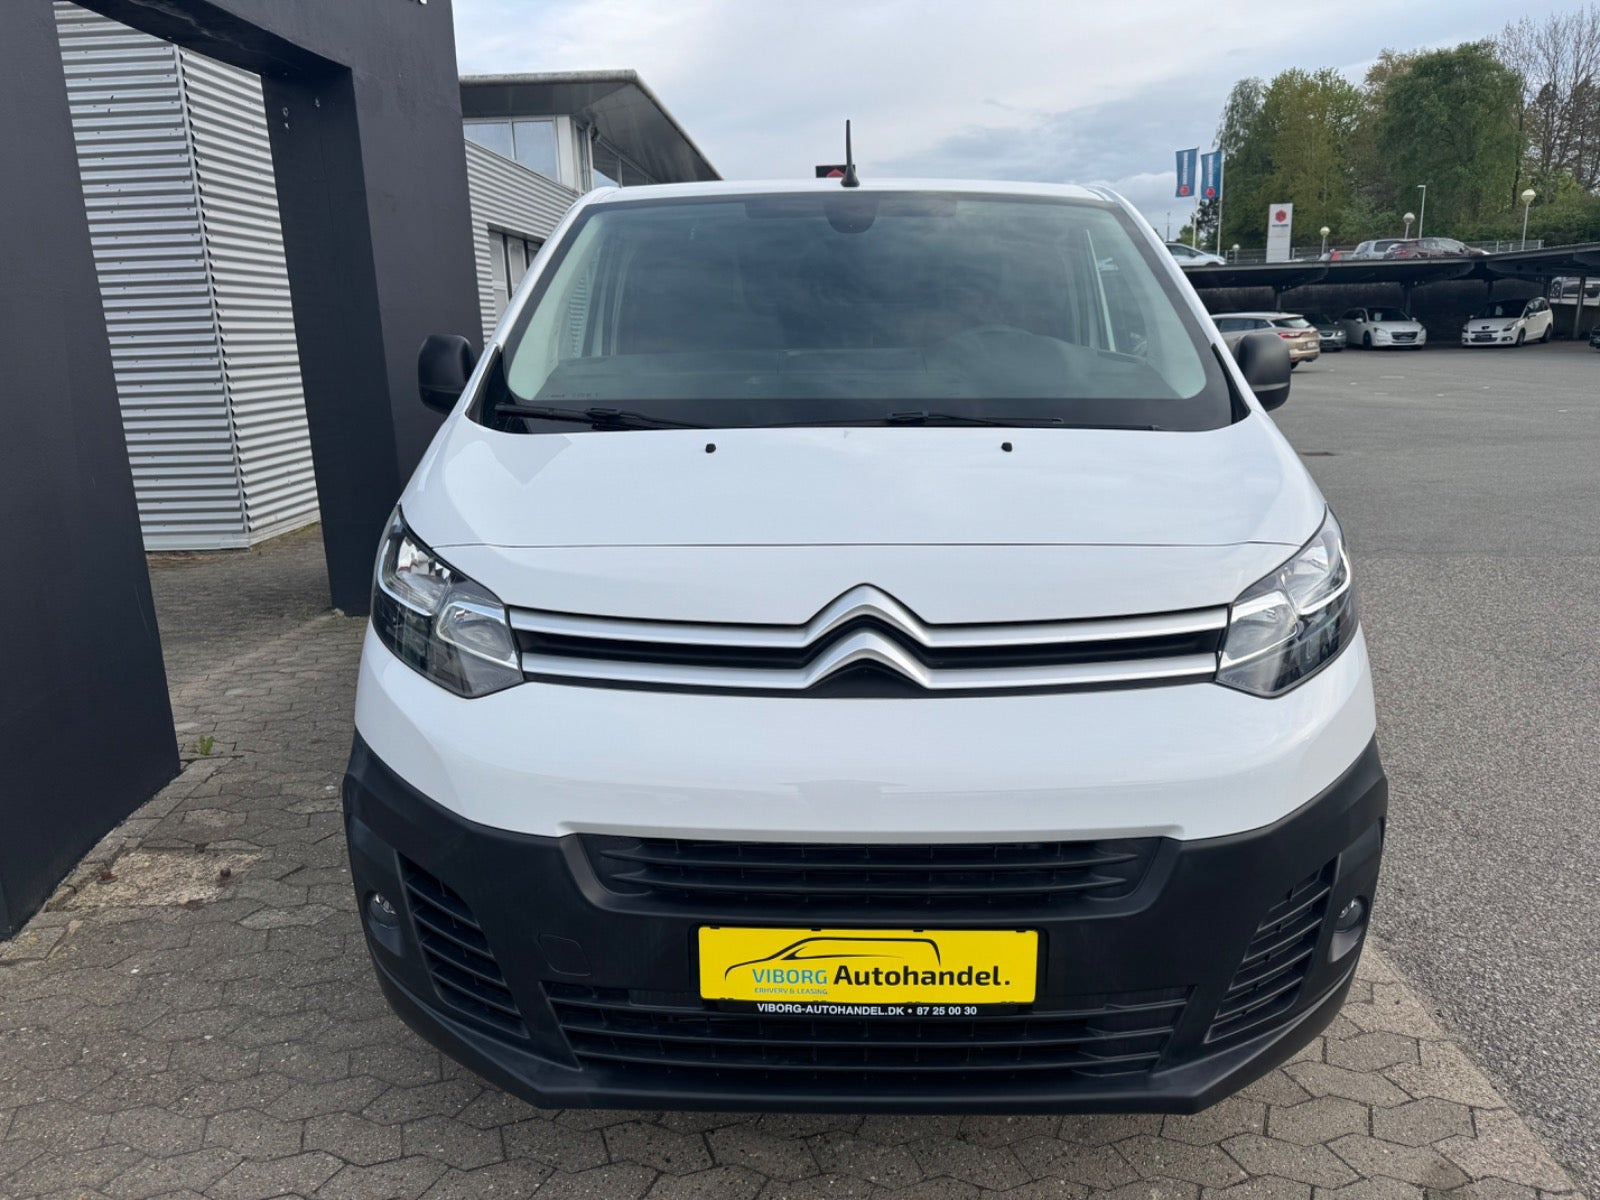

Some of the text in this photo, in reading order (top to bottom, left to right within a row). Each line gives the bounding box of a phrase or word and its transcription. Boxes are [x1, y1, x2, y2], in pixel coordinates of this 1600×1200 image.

[752, 965, 1010, 986] VIBORG Autohandel.
[756, 1003, 978, 1016] VIBORG-AUTOHANDEL.DK 87 25 00 30
